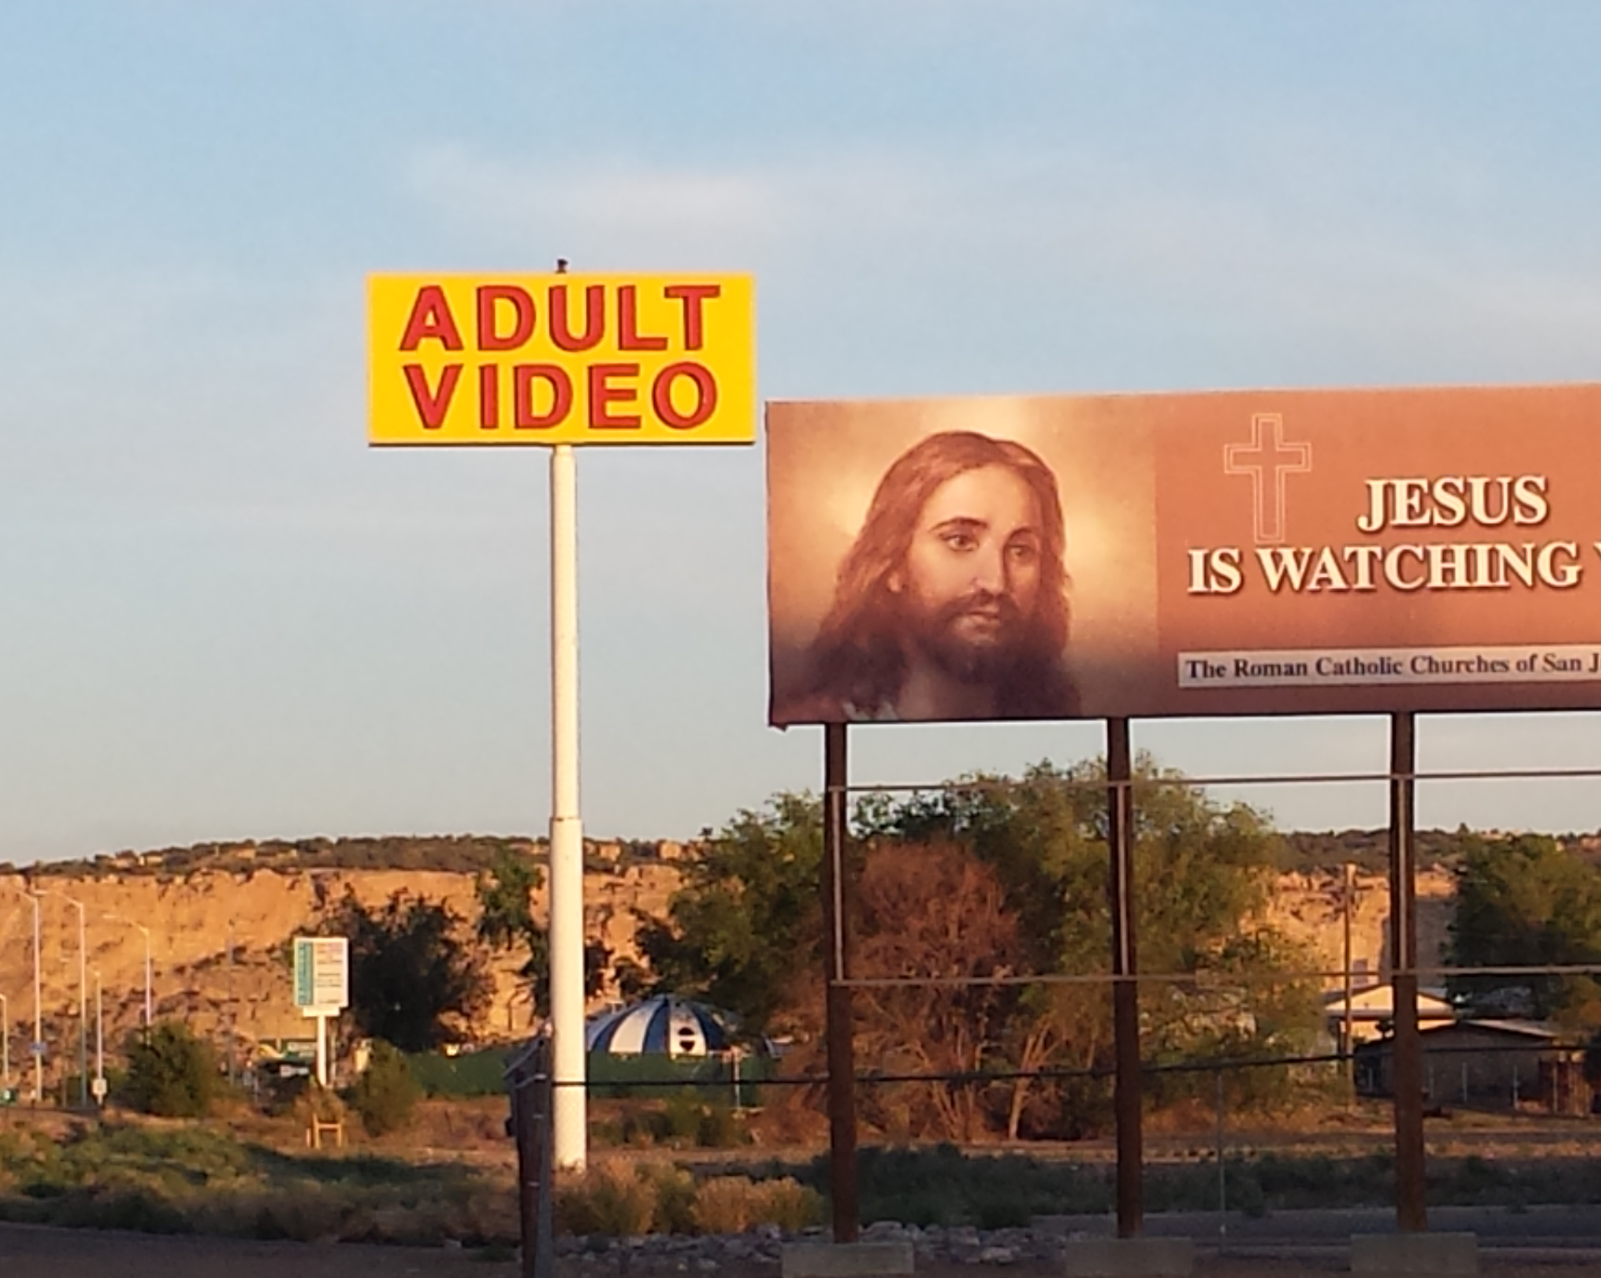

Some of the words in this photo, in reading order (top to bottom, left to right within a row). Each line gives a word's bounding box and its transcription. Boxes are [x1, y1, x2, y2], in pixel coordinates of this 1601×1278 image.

[398, 284, 721, 352] ADULT
[402, 361, 718, 430] VIDEO
[1357, 475, 1549, 532] JESUS
[1187, 548, 1243, 594] IS
[1254, 542, 1583, 592] WATCHING
[1186, 659, 1226, 679] The
[1233, 658, 1308, 678] Roman
[1315, 656, 1403, 676] Catholic
[1410, 655, 1509, 675] Churches
[1515, 654, 1537, 673] of
[1542, 653, 1582, 673] San
